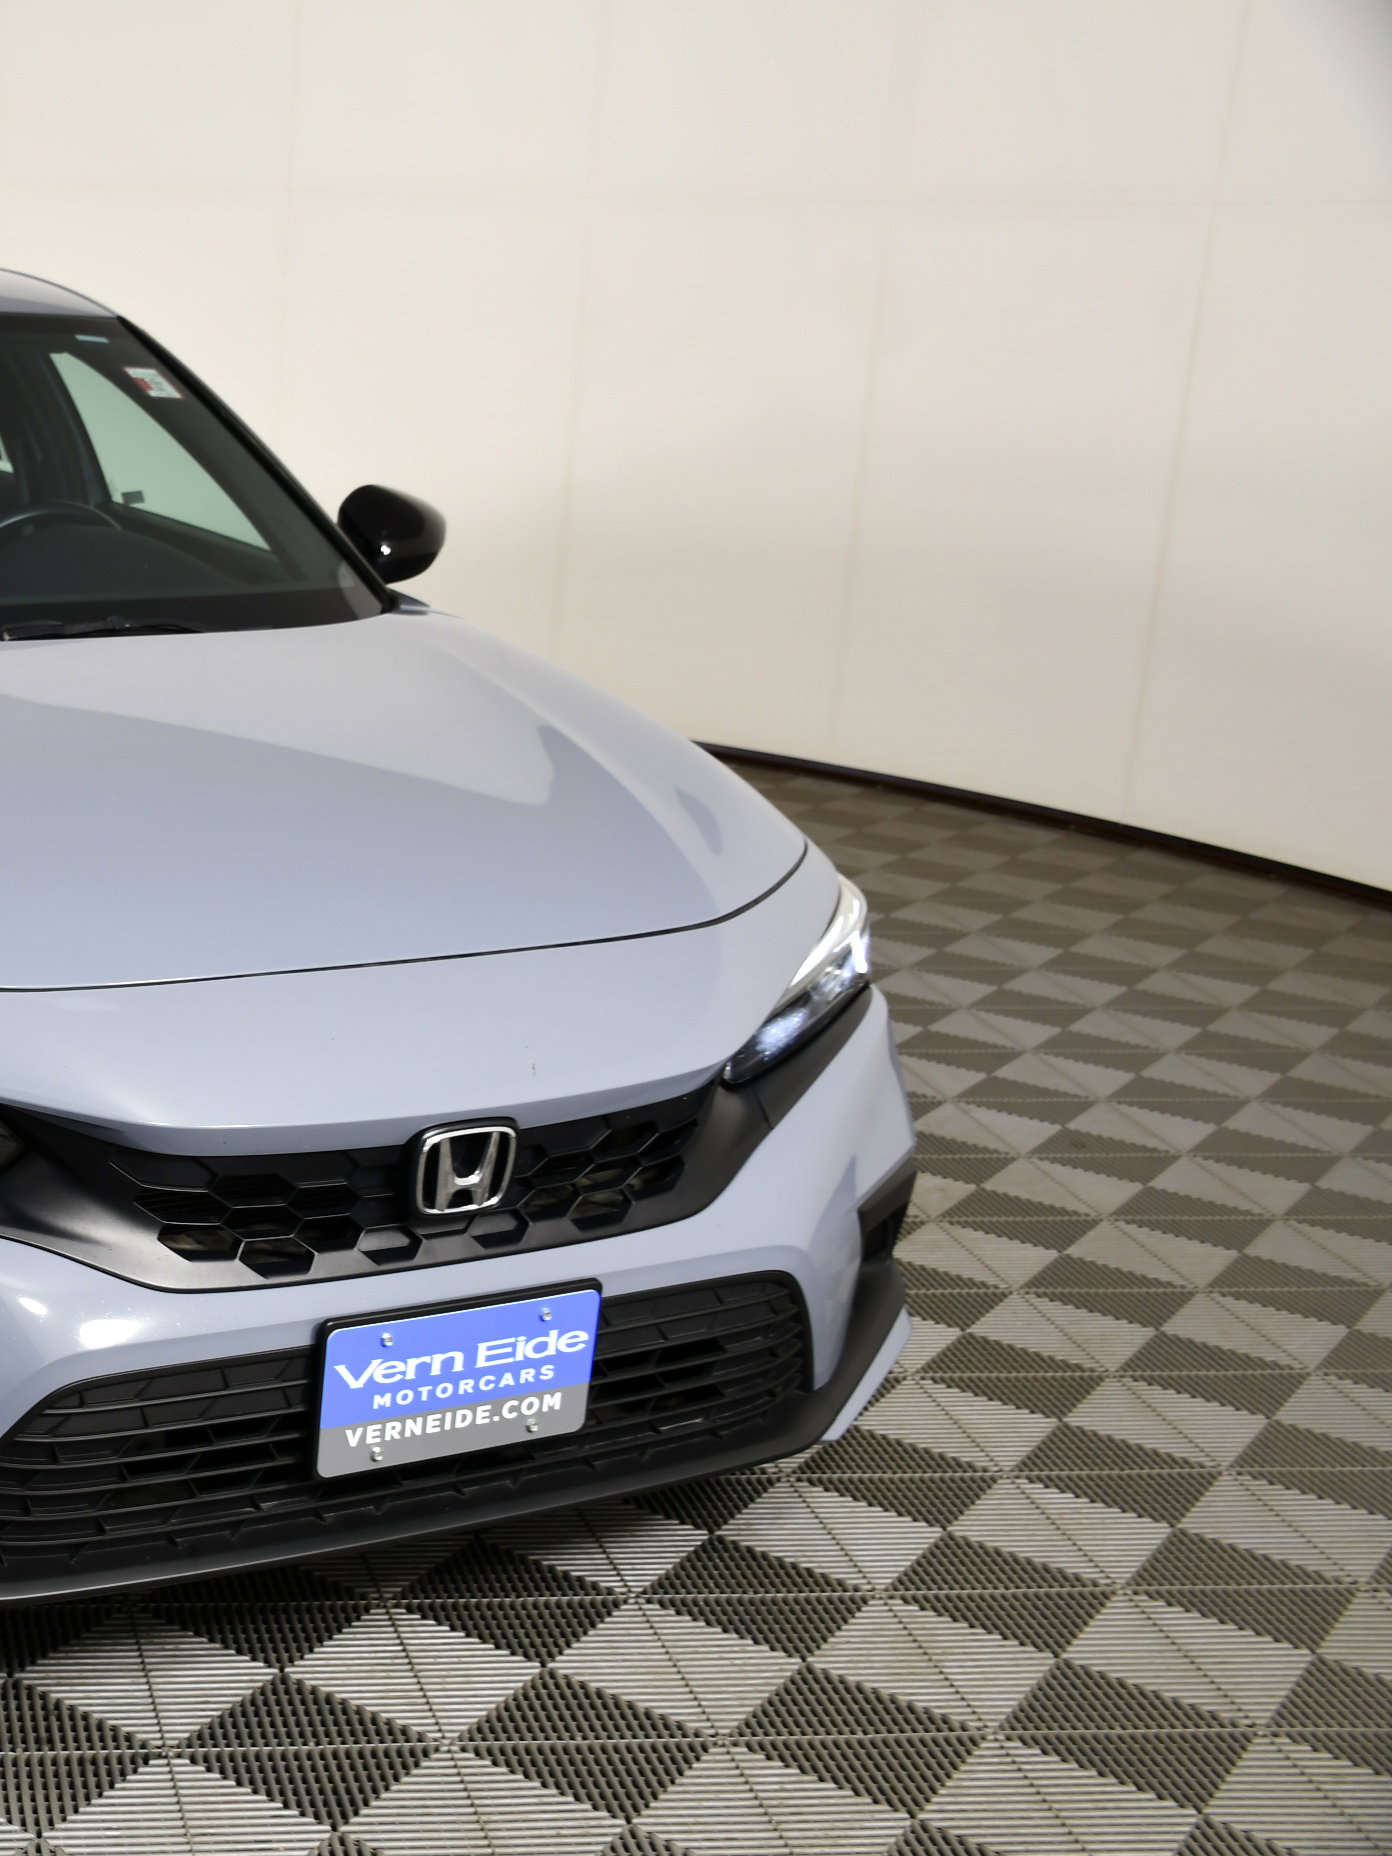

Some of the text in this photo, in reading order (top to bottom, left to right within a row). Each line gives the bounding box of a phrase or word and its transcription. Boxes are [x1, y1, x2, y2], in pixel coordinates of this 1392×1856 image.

[333, 1329, 589, 1389] Vern Eide
[372, 1364, 555, 1410] MOTORCARS
[345, 1392, 562, 1448] VERNEIDE.COM
